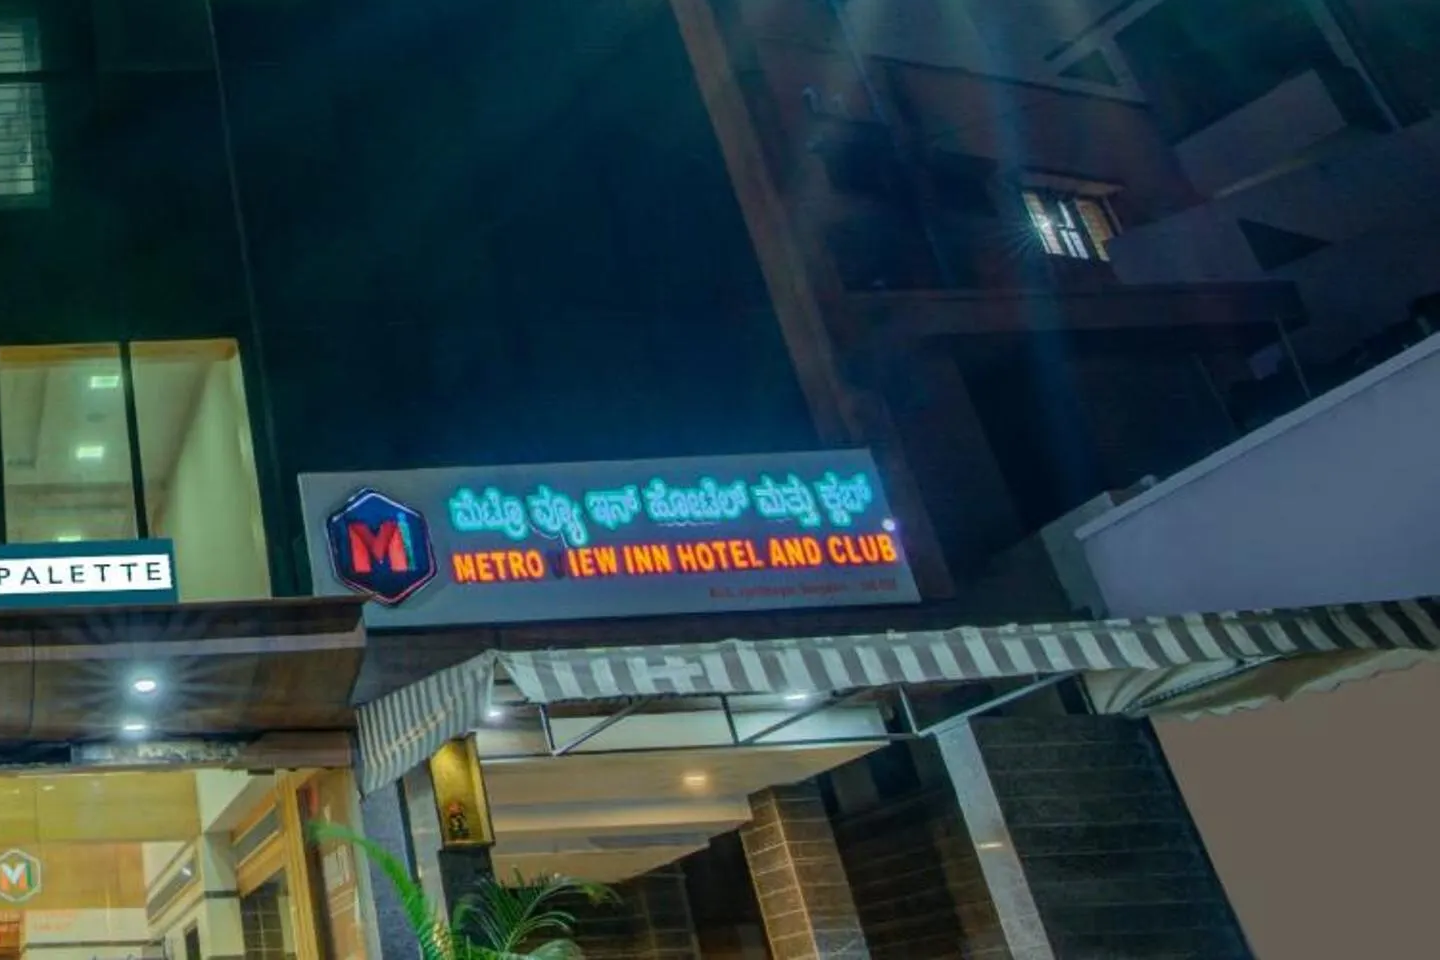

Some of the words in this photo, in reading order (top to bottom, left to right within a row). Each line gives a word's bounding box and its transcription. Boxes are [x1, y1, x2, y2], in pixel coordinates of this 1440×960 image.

[452, 548, 545, 583] METRO
[622, 543, 673, 575] INN
[675, 538, 764, 573] HOTEL
[768, 535, 823, 568] AND
[826, 533, 898, 565] CLUB
